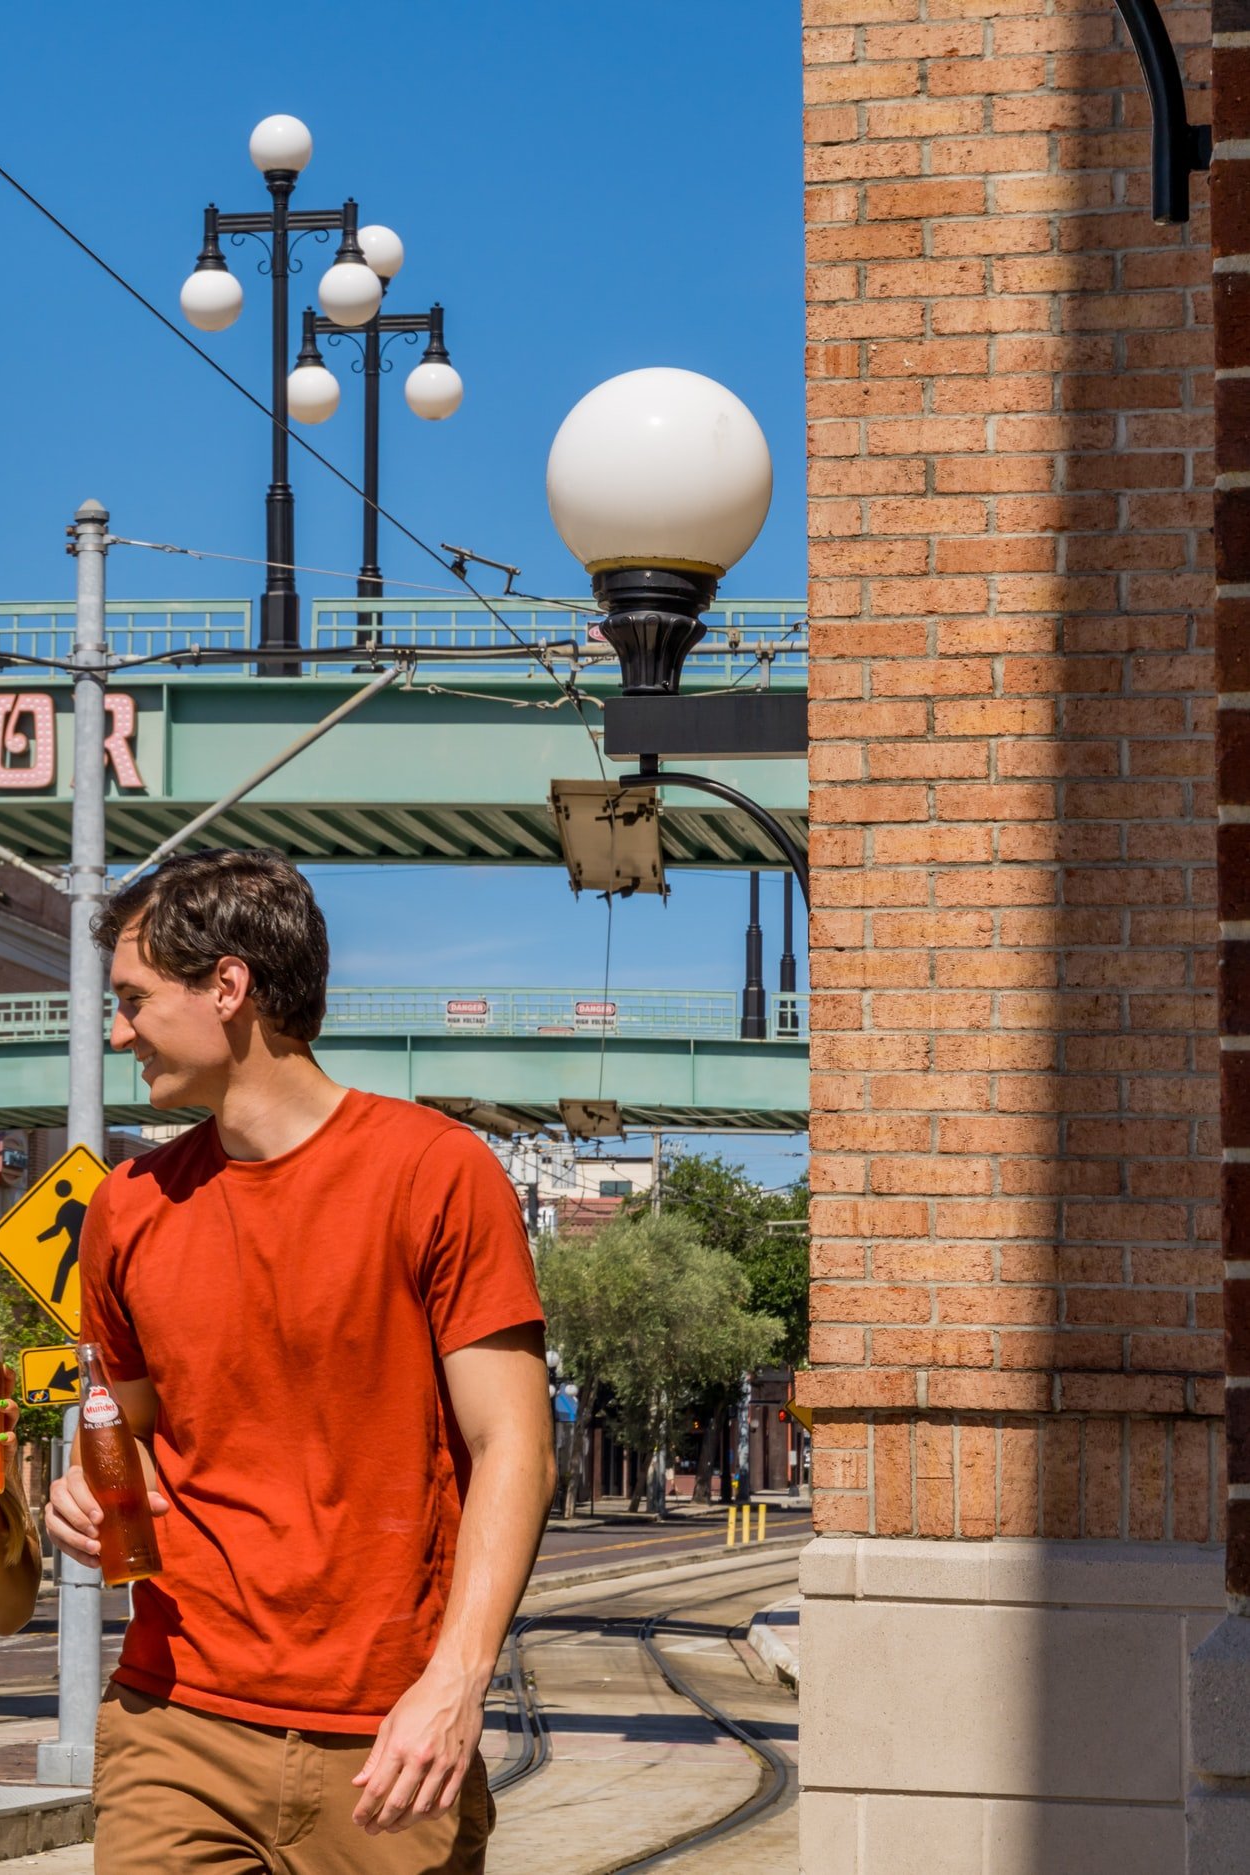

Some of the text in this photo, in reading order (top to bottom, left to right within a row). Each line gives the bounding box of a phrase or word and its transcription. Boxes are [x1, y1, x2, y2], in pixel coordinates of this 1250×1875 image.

[451, 1003, 484, 1011] DANGER
[579, 1005, 612, 1013] DANGER
[86, 1403, 116, 1414] Mundet
